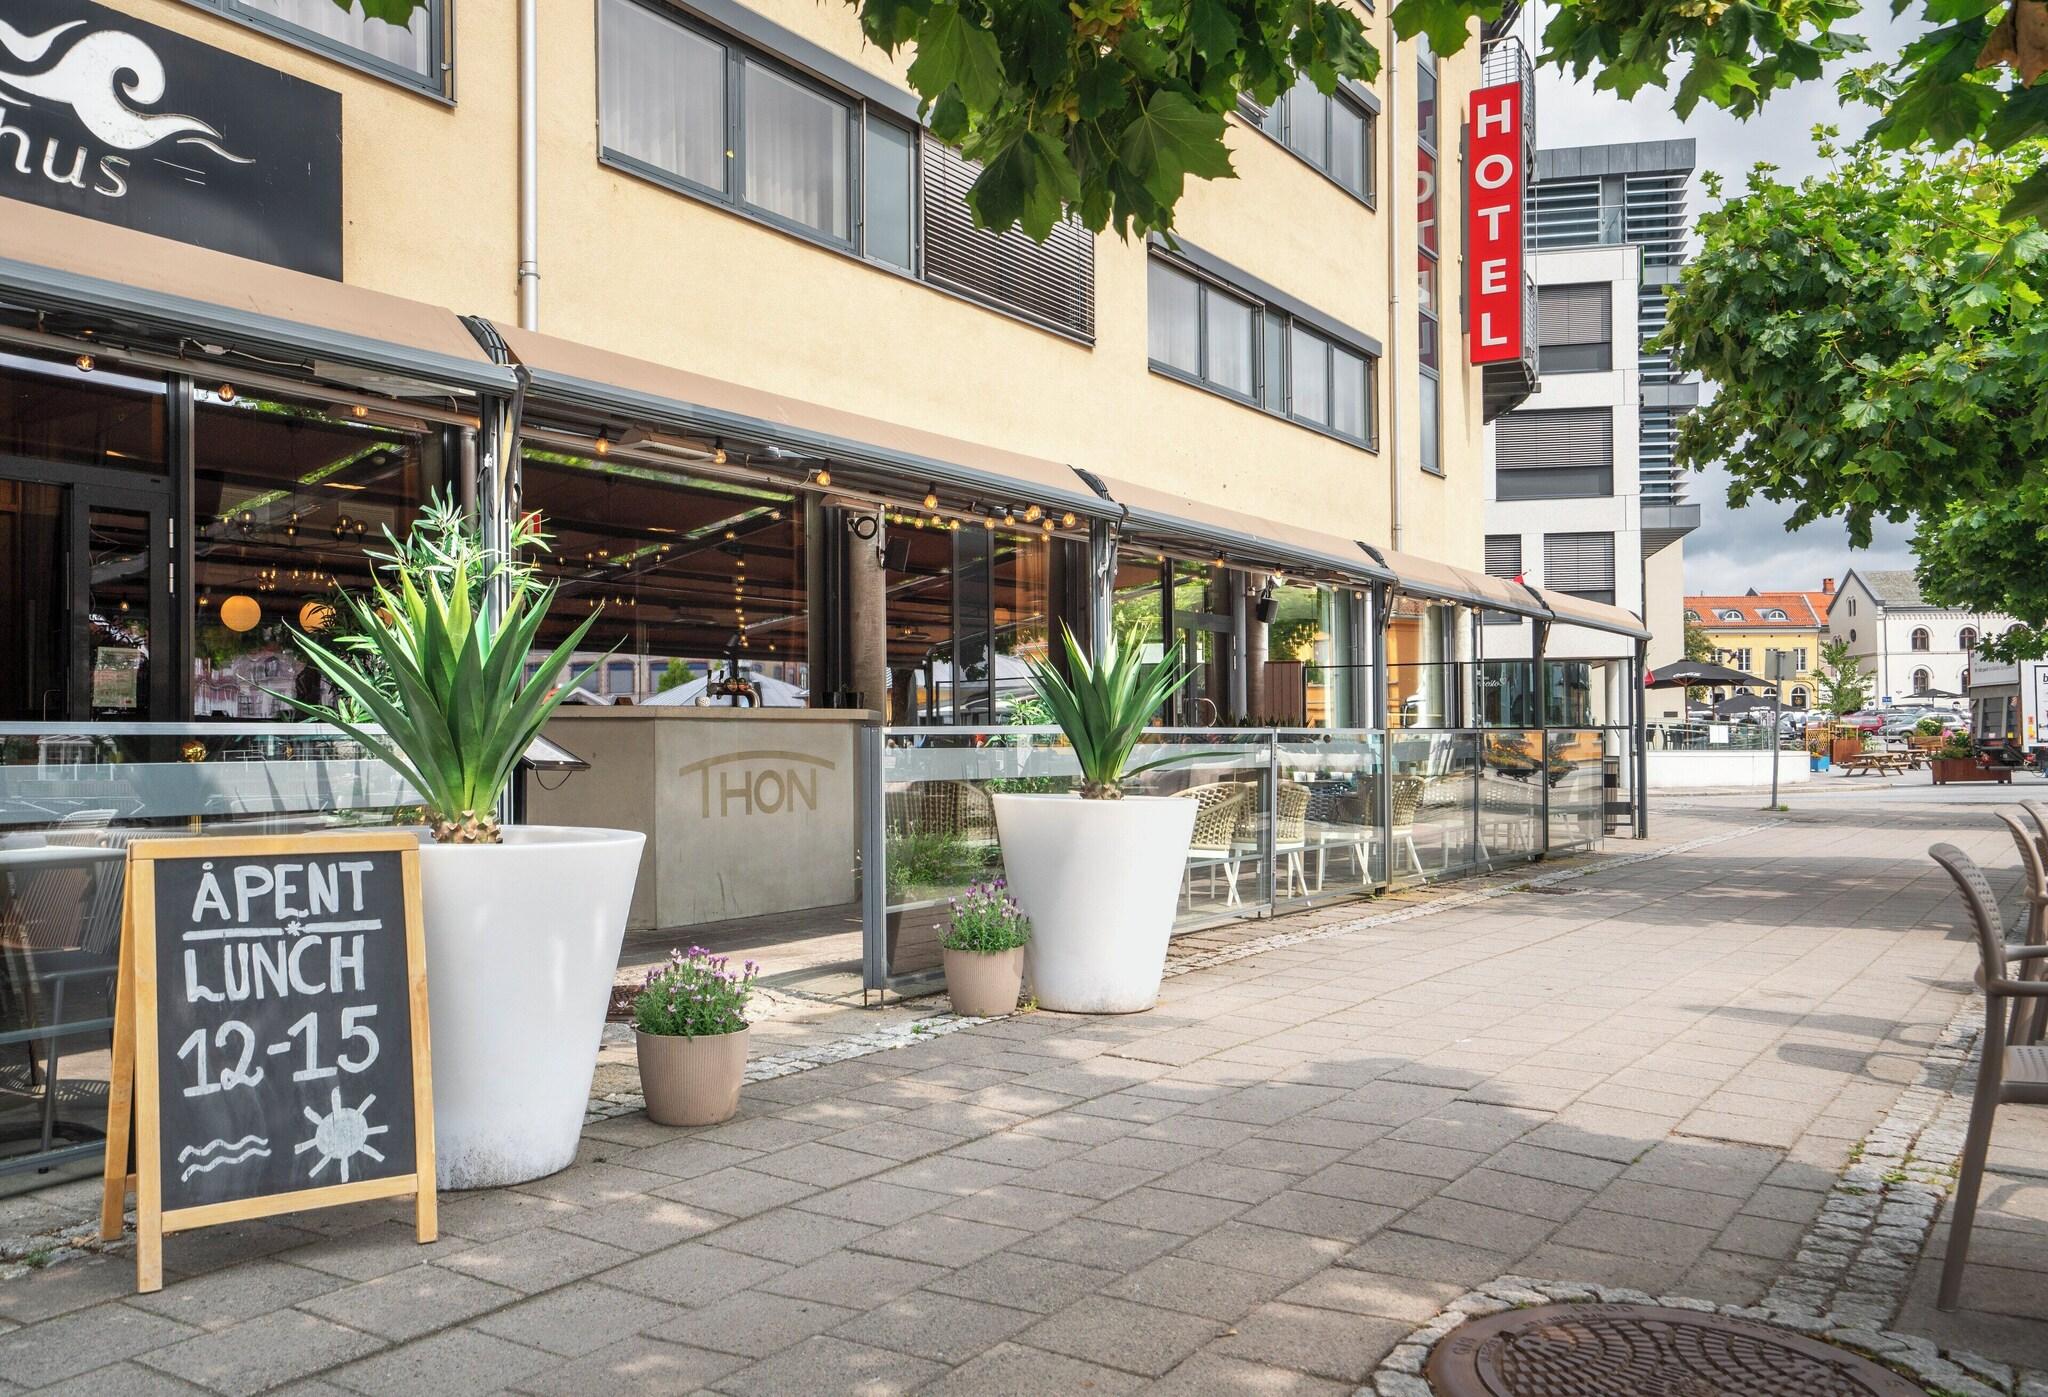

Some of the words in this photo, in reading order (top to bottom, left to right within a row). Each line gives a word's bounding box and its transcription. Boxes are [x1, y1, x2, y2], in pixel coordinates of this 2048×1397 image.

[1475, 99, 1514, 347] HOTEL
[680, 750, 835, 818] THON
[192, 861, 373, 922] ÅPENT
[182, 936, 366, 1002] LUNCH
[177, 1004, 380, 1097] 12-15
